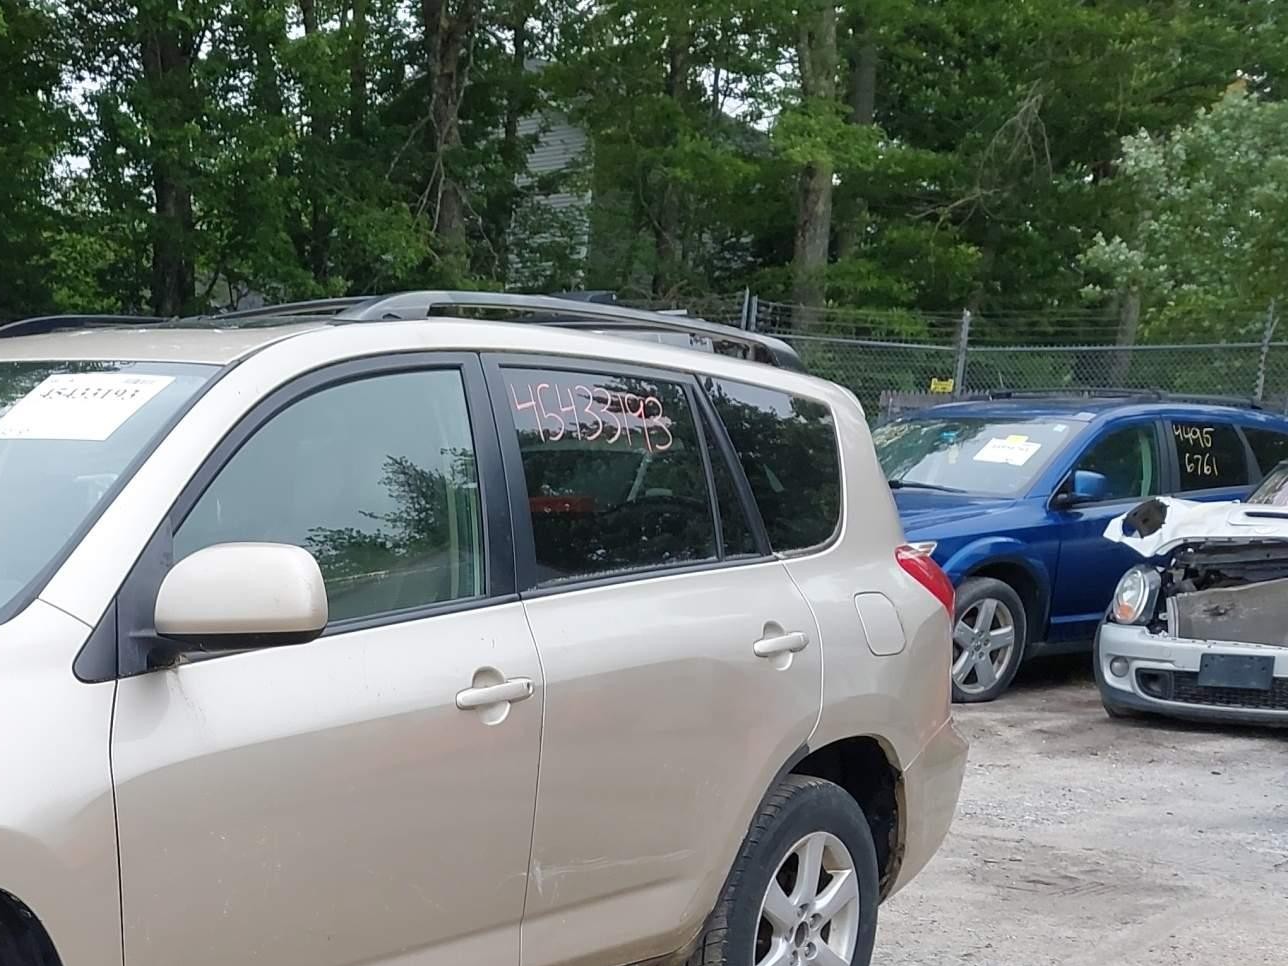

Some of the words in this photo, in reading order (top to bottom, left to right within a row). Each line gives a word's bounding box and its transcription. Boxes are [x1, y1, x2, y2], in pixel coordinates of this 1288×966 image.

[510, 383, 673, 453] 45433193
[1173, 424, 1215, 448] 4495
[1185, 453, 1219, 476] 6761
